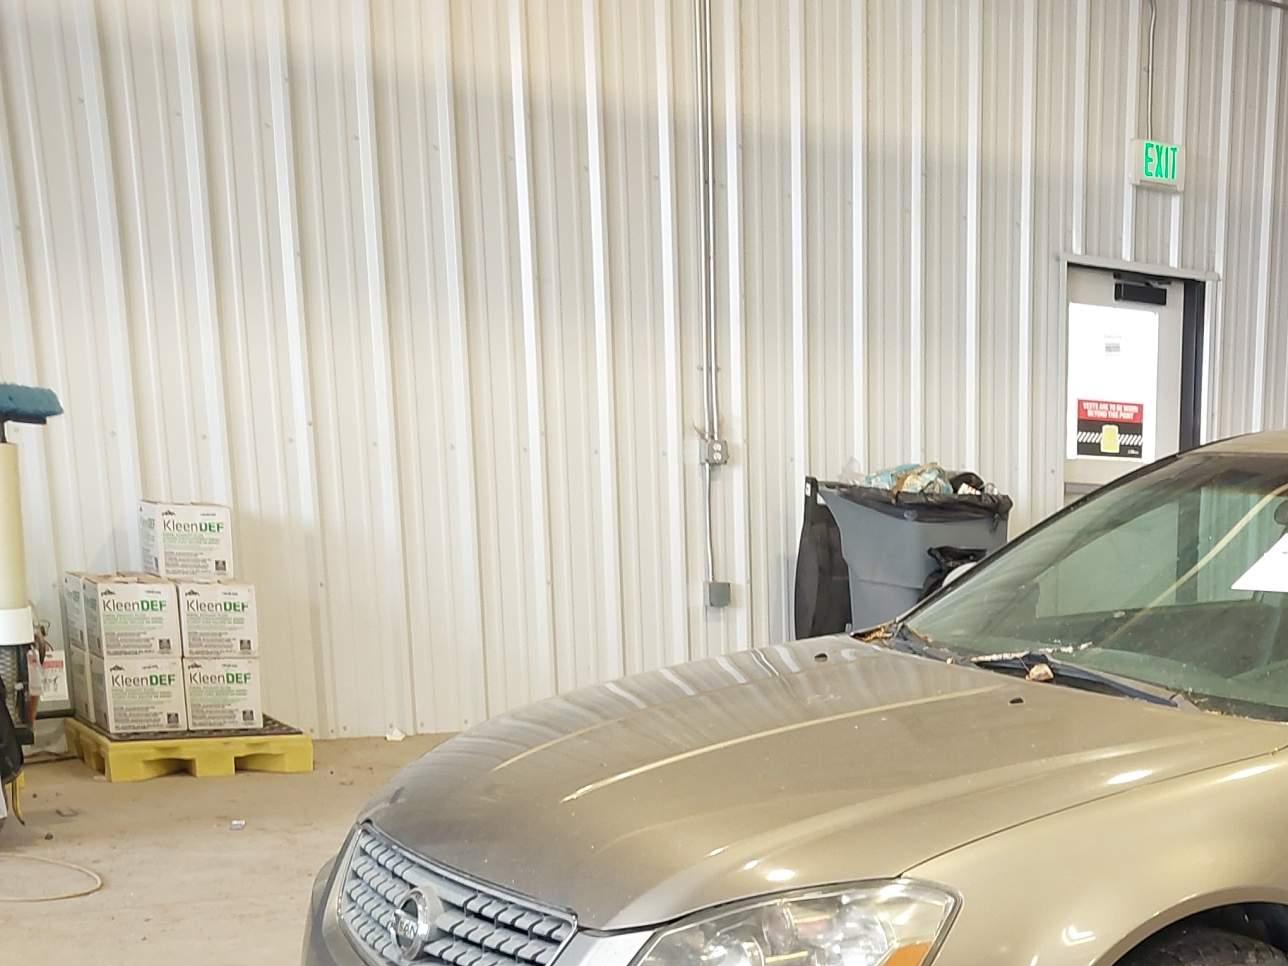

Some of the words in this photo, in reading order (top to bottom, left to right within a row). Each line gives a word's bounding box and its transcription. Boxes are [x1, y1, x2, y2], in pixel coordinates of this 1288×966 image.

[1144, 143, 1177, 179] EXIT
[163, 519, 225, 533] KleenDEF
[102, 599, 167, 612] KleenDEF
[186, 599, 249, 613] KleenDEF
[111, 674, 176, 687] KleenDEF
[189, 671, 252, 685] KleenDEF
